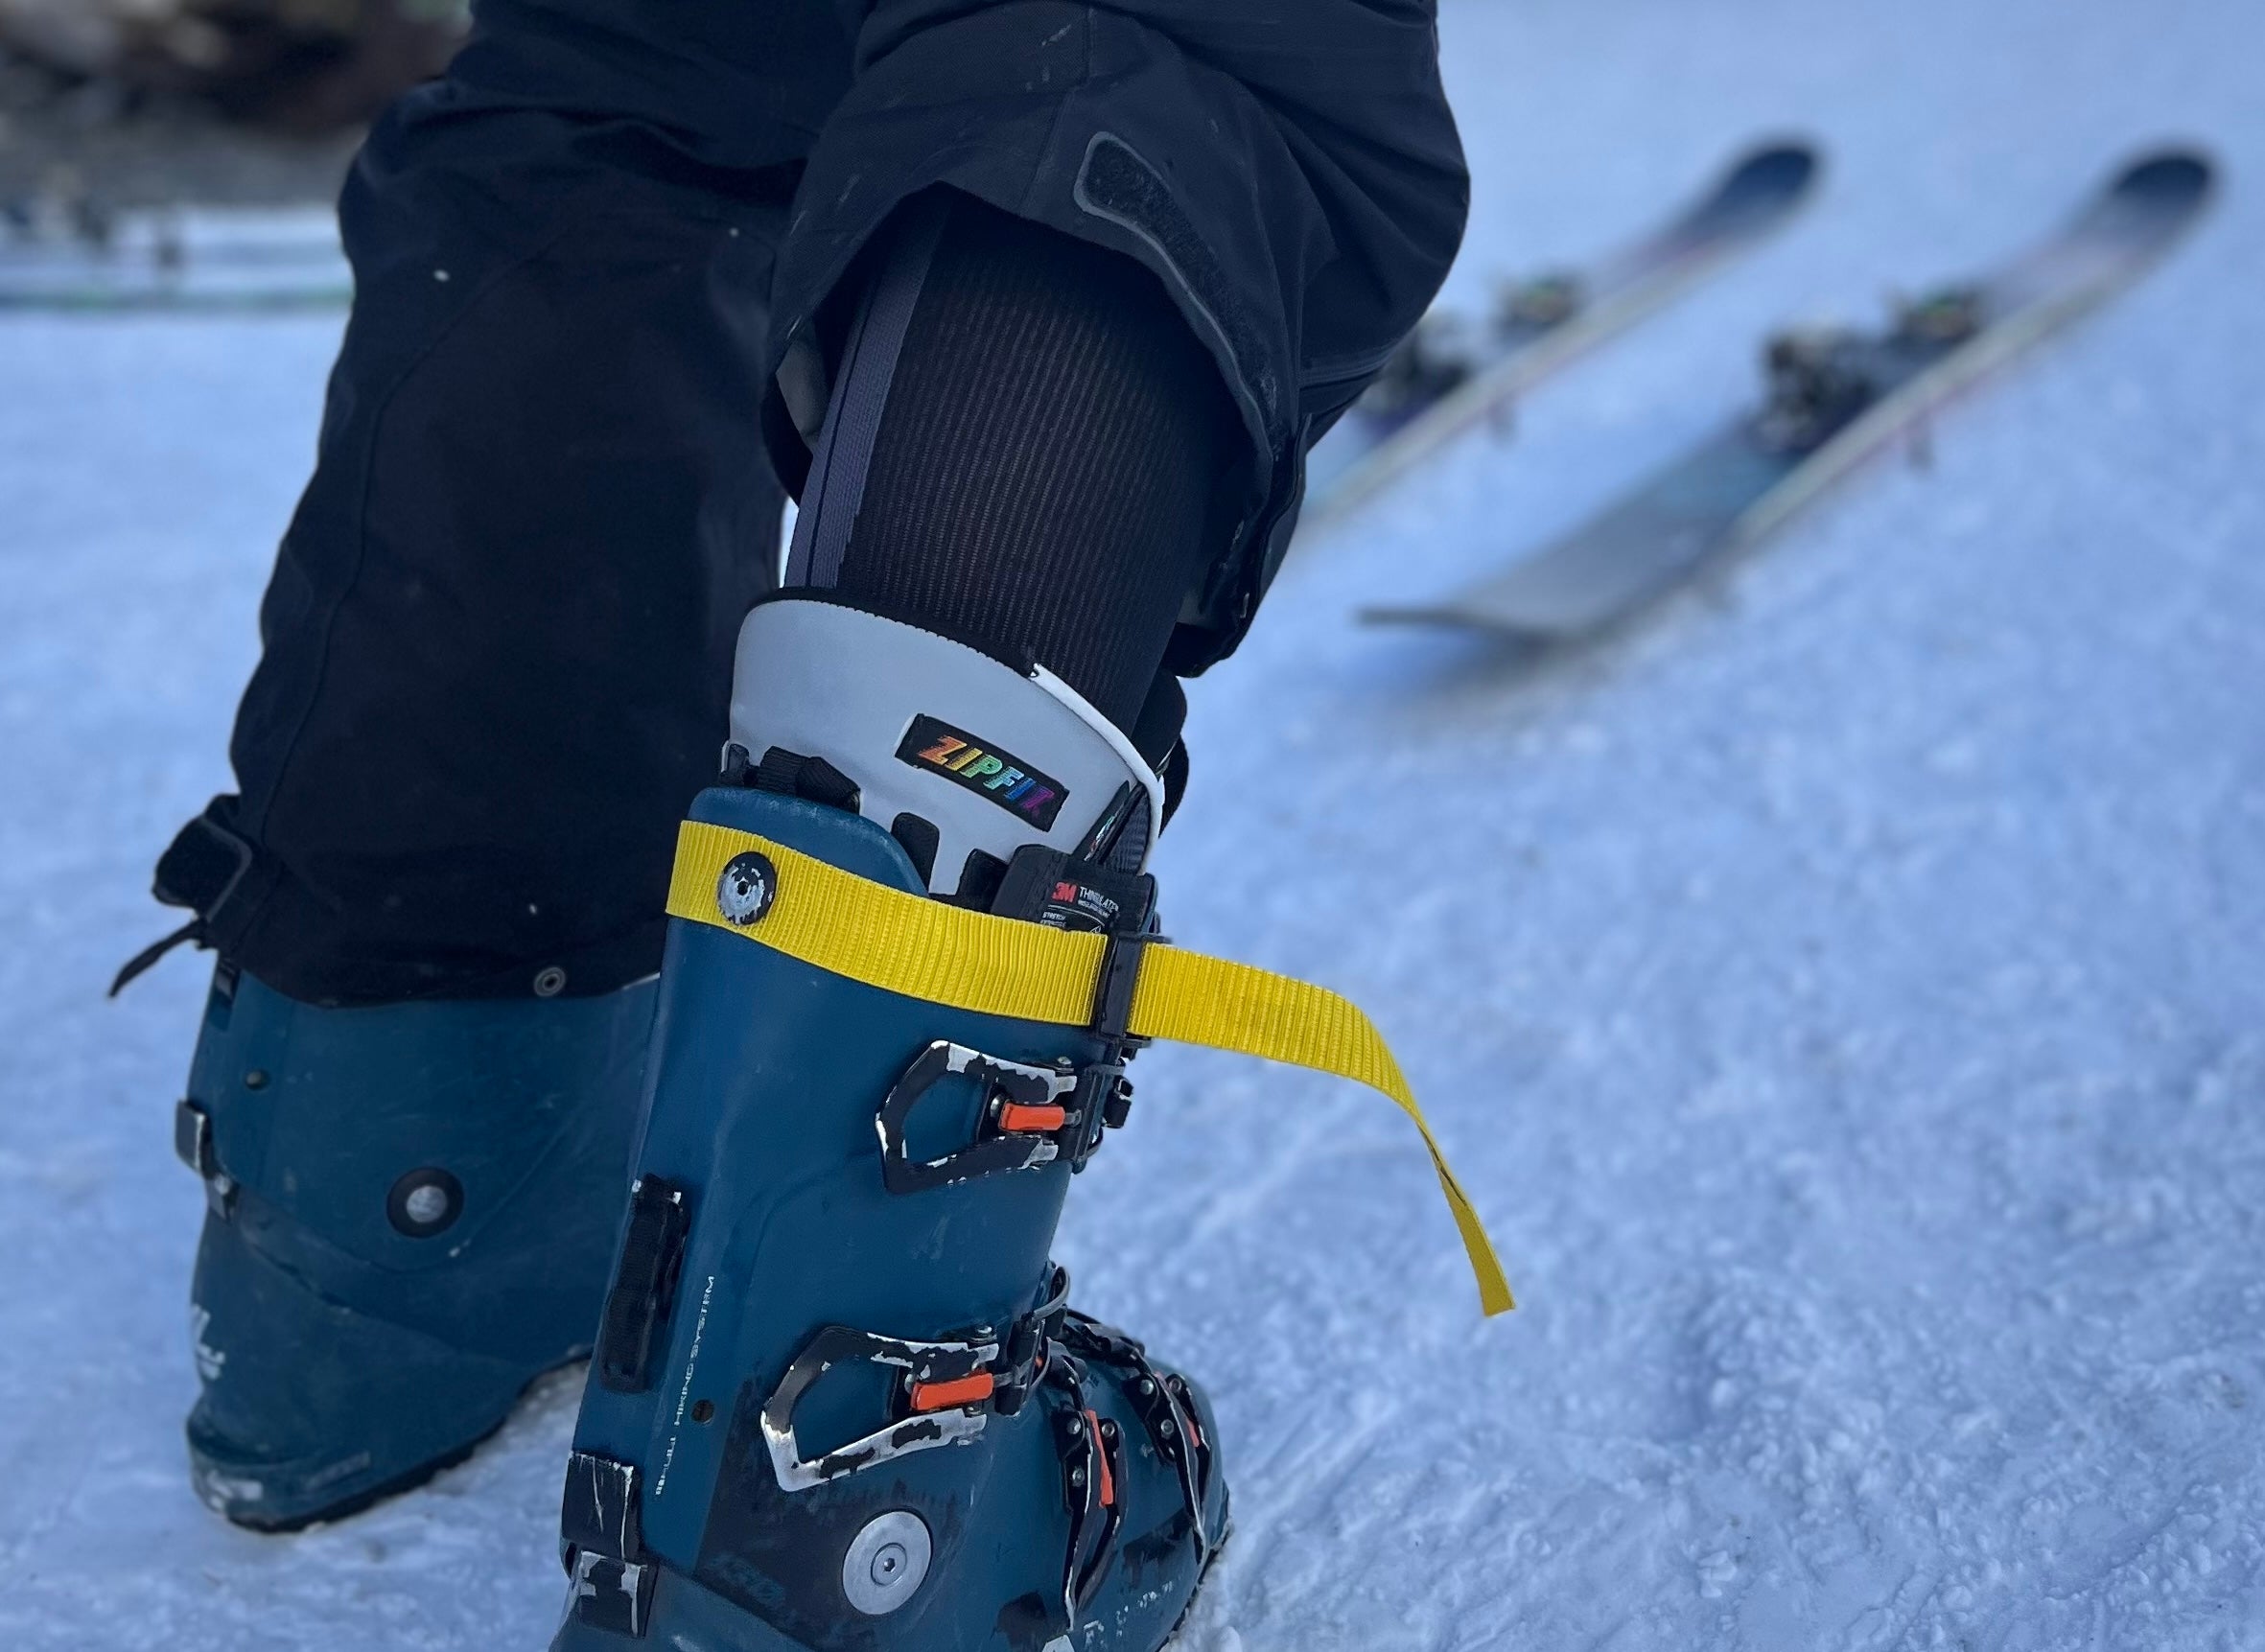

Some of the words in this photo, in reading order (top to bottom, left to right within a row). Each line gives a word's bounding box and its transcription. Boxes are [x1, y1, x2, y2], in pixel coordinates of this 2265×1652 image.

[918, 734, 1054, 817] ZIPFIT
[1051, 881, 1078, 902] 3M
[673, 1364, 694, 1426] HIKING
